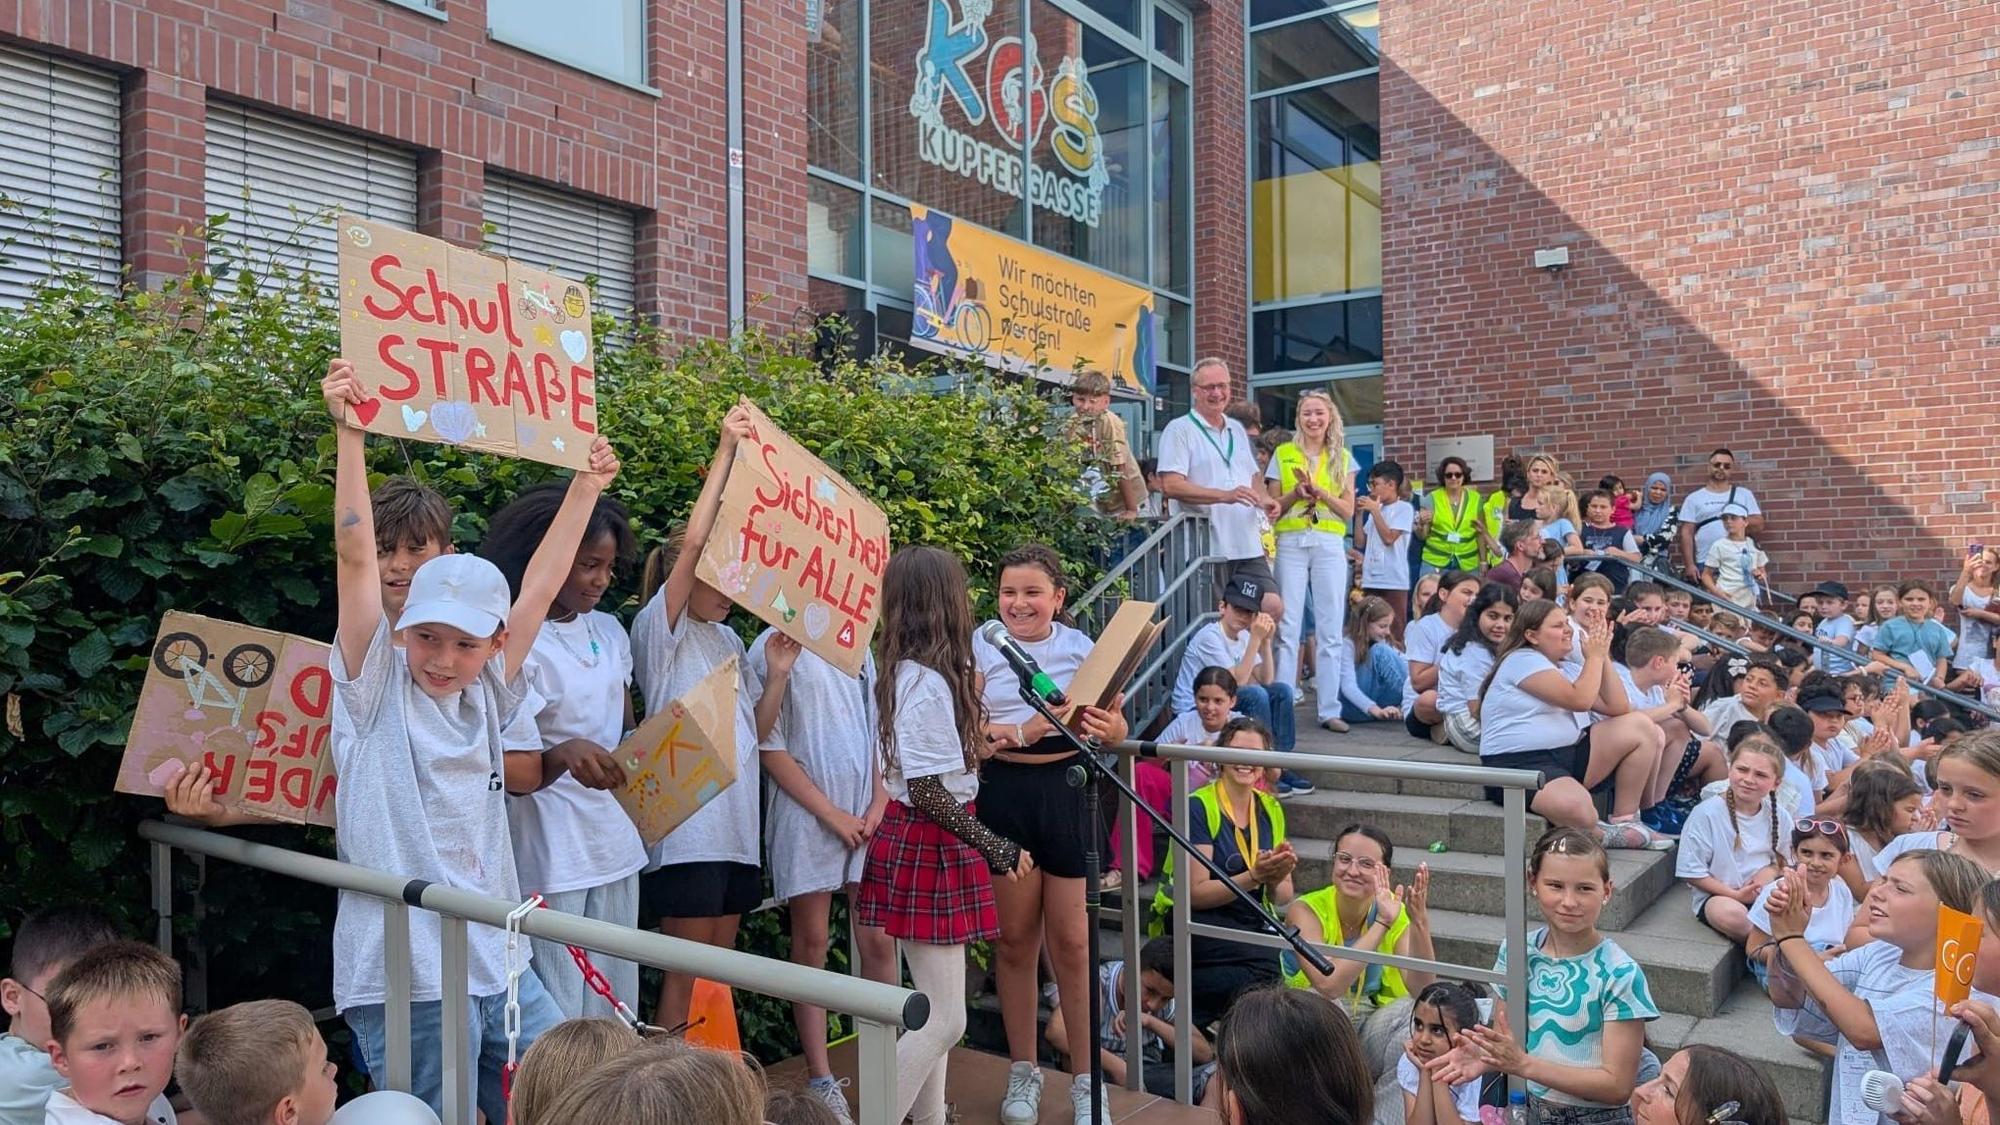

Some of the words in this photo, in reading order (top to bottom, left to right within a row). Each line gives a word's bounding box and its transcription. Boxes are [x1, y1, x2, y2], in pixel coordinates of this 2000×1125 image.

[921, 121, 1099, 225] KUPFERGASSE
[363, 254, 523, 348] Schul
[998, 254, 1026, 284] Wir
[1031, 272, 1096, 308] möchten
[999, 284, 1091, 333] Schulstraße
[1001, 317, 1061, 351] werden!
[755, 443, 889, 577] Sicherheit
[740, 504, 800, 571] für
[797, 545, 876, 624] ALLE
